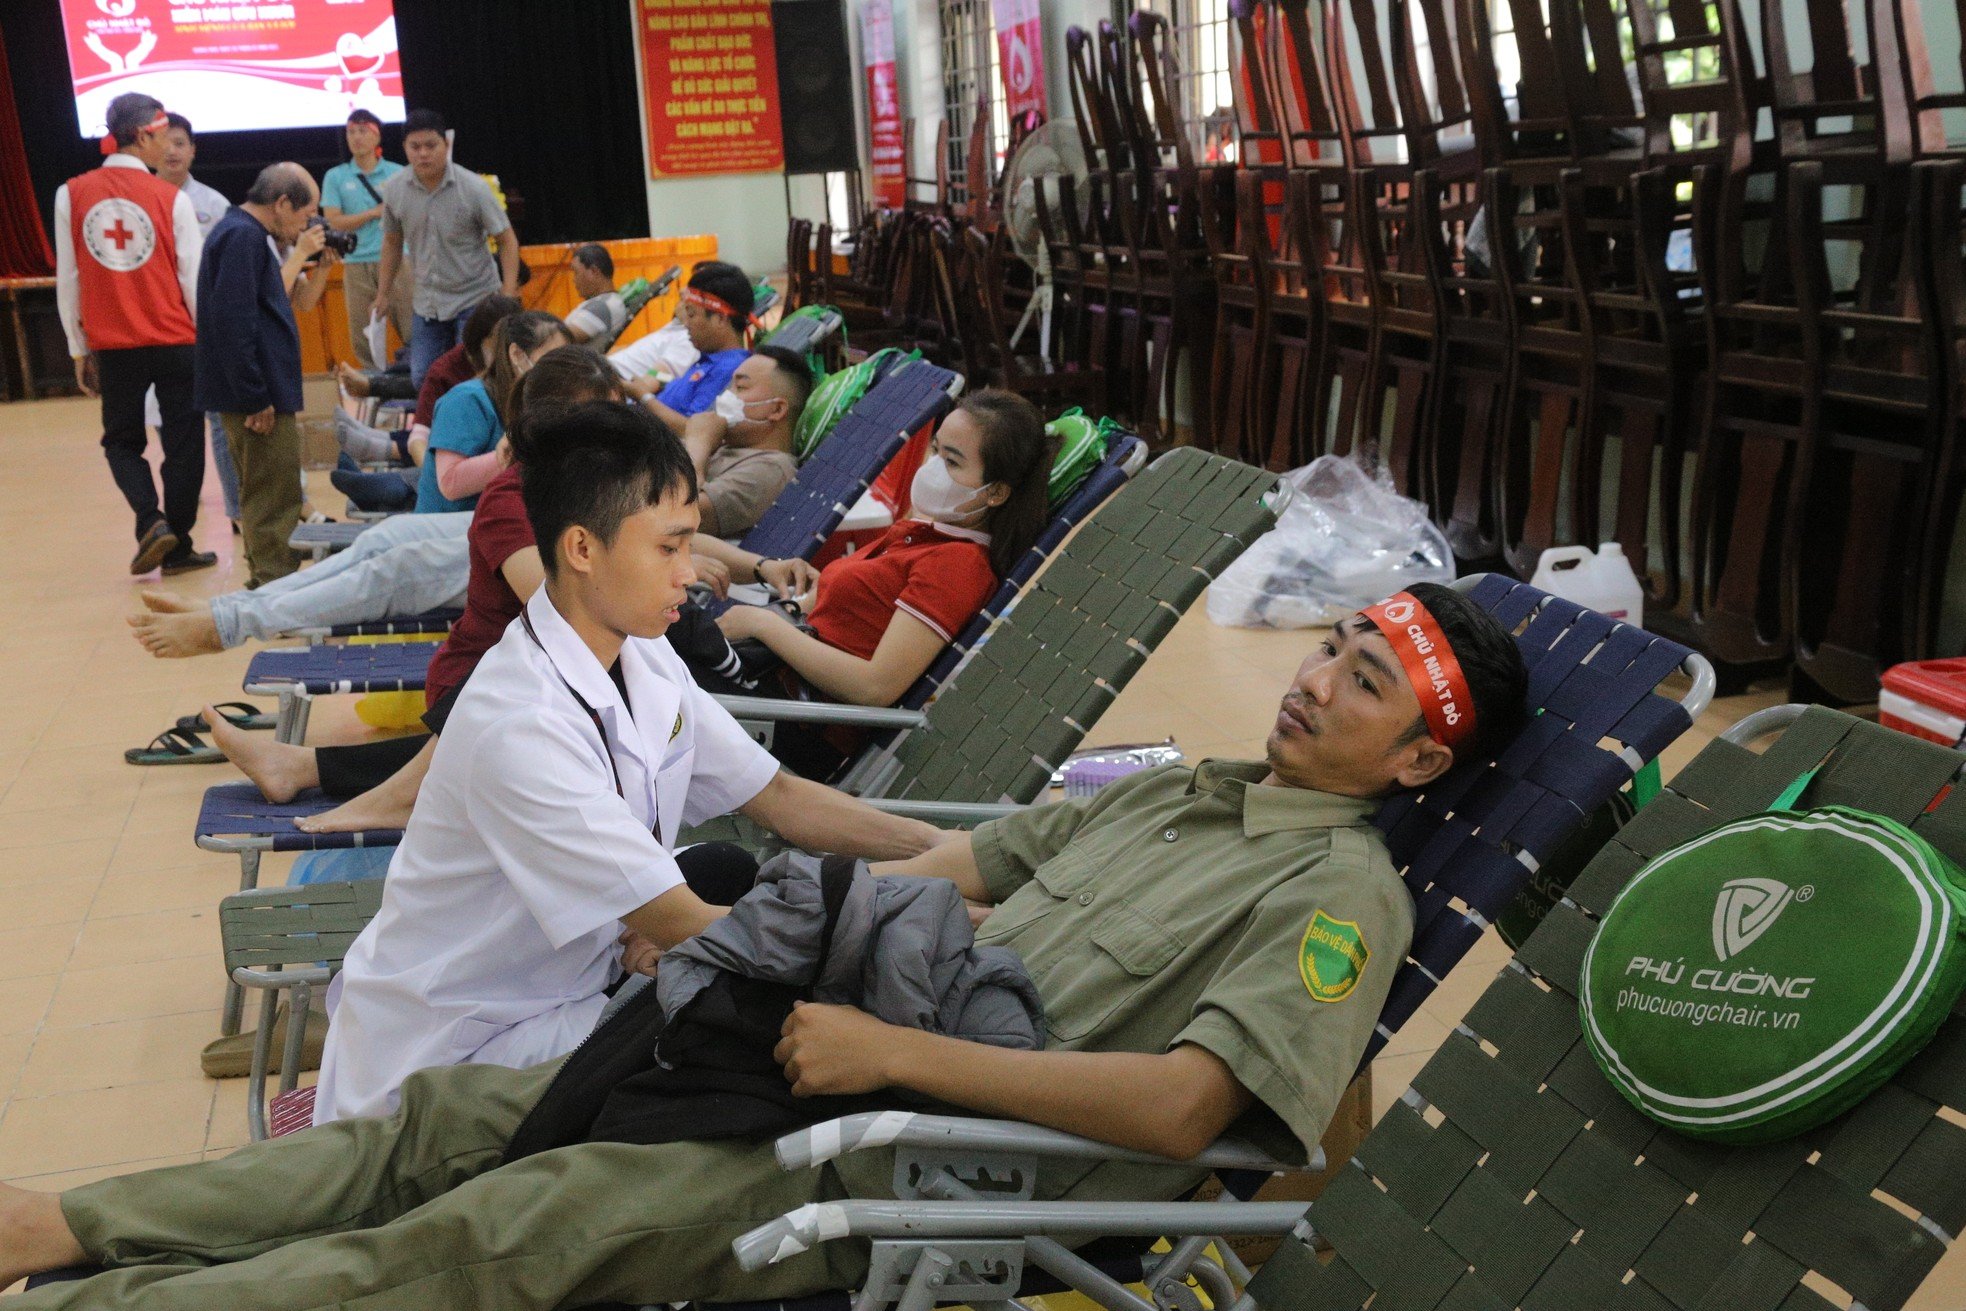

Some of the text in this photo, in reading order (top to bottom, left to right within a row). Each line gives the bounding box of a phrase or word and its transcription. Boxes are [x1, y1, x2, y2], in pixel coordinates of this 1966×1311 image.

[1407, 624, 1462, 726] CHỦ NHẬT ĐỎ
[1625, 956, 1816, 999] PHÚ CƯỜNG
[1615, 987, 1801, 1030] phucuongchair.vn
